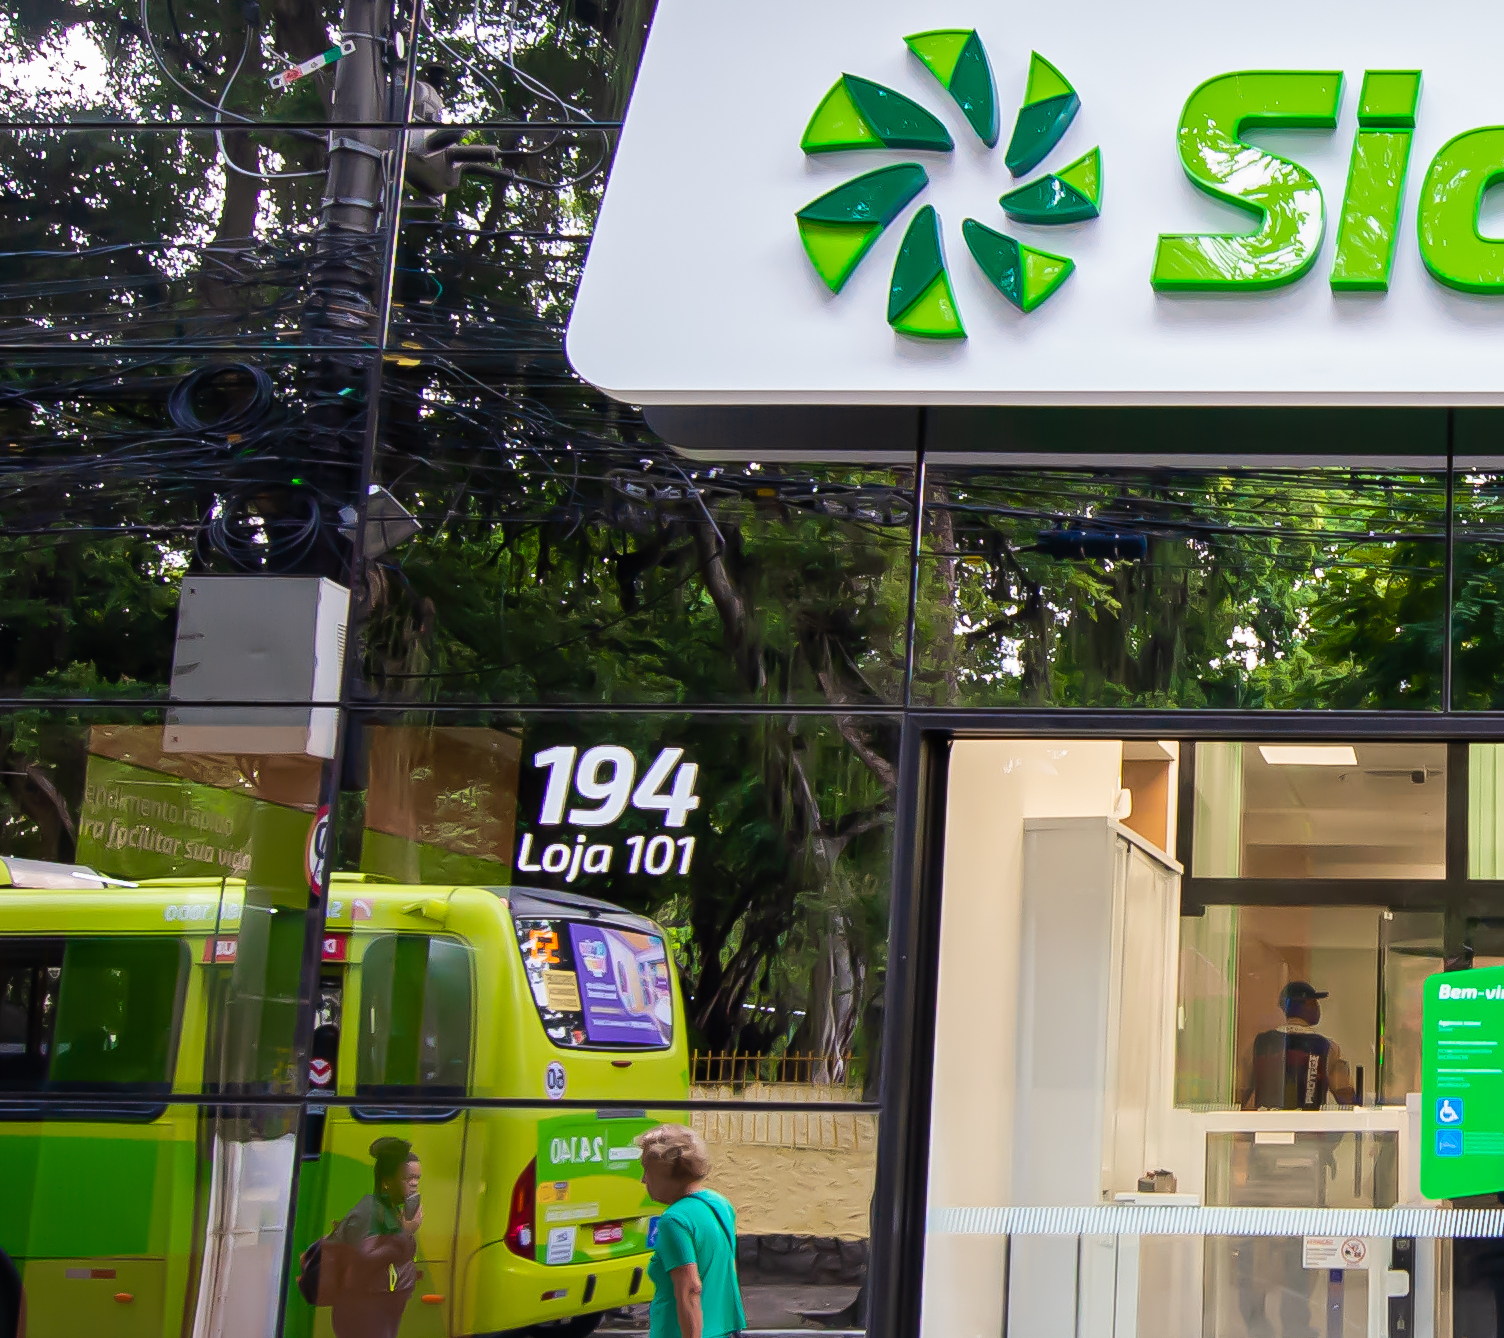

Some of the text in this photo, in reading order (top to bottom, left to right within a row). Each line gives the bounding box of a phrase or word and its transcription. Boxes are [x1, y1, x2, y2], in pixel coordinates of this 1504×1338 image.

[534, 745, 700, 828] 194
[516, 832, 695, 882] Loja 101
